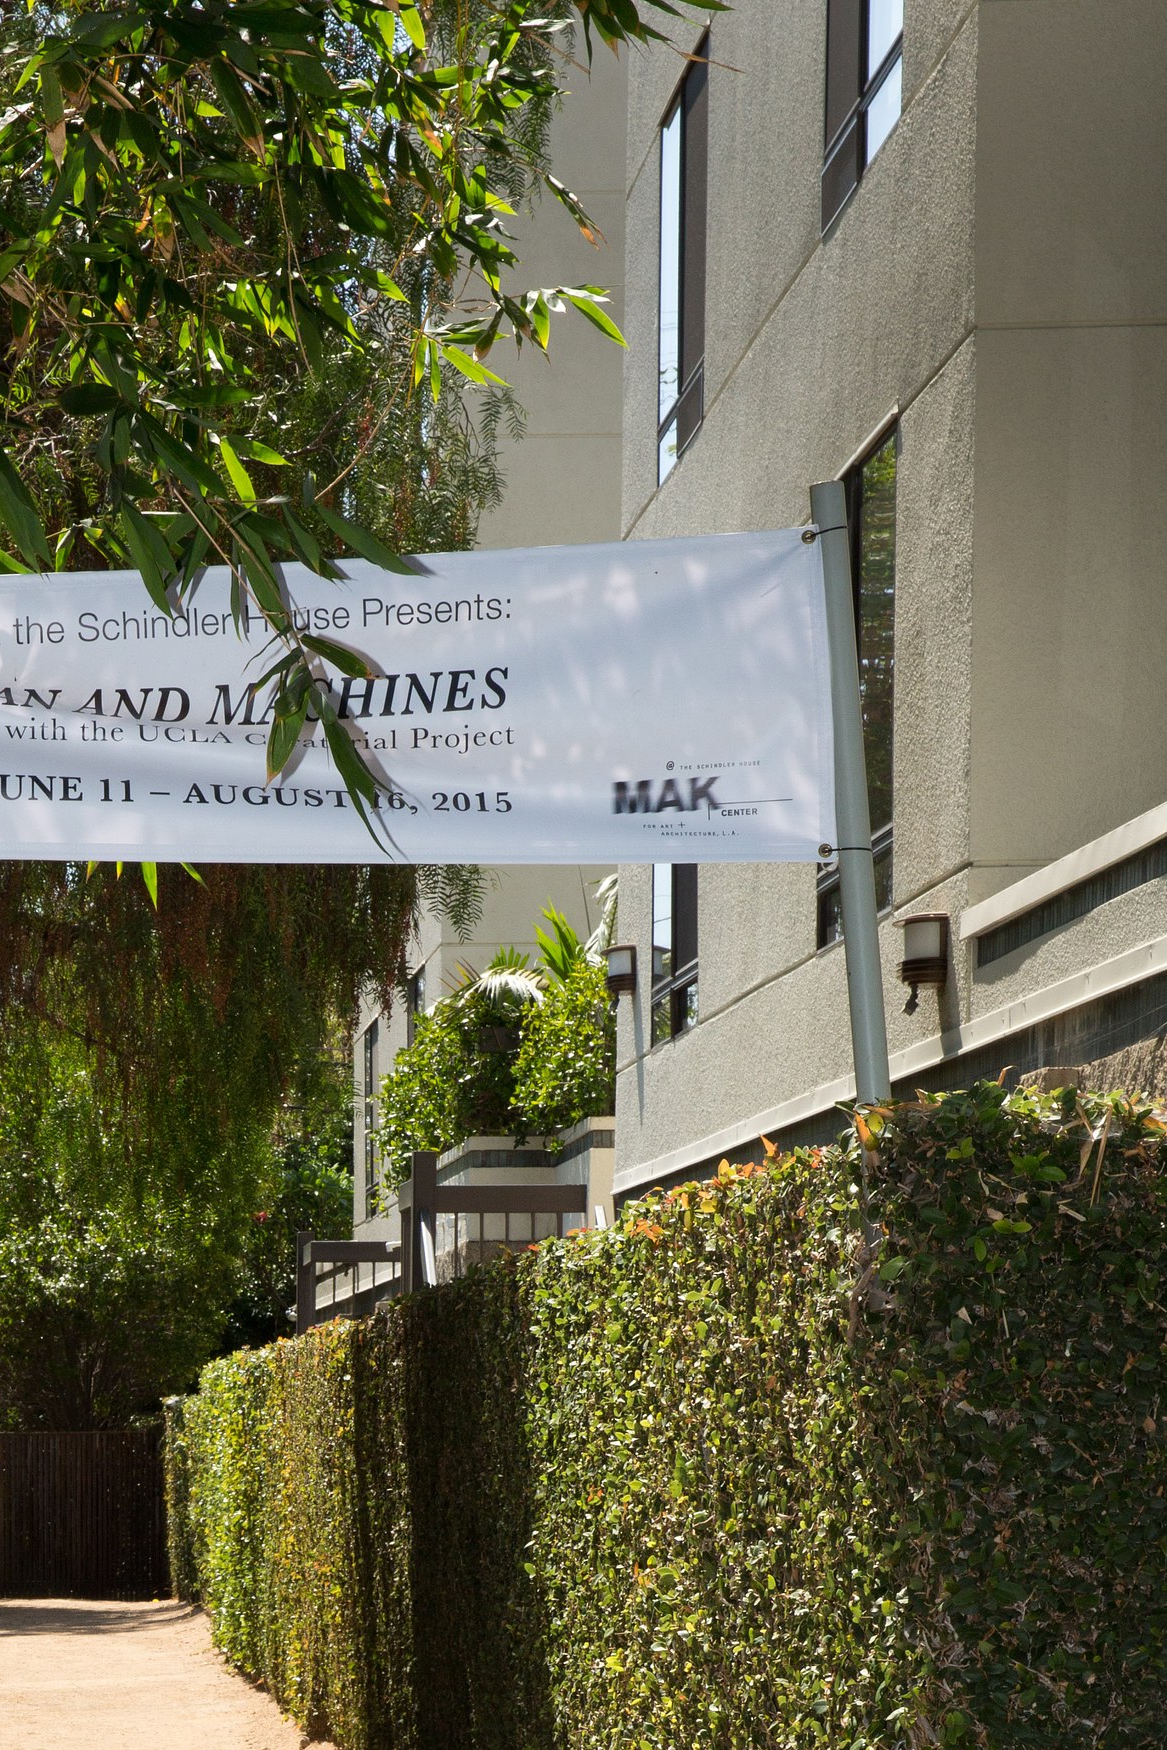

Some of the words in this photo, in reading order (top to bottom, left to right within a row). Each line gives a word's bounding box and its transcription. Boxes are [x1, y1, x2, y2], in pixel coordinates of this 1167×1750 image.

[14, 615, 65, 645] the
[77, 606, 232, 642] Schindler
[245, 604, 350, 634] Huse
[362, 594, 512, 629] Presents:
[72, 687, 190, 722] AND
[6, 717, 67, 742] with
[81, 720, 124, 742] the
[137, 724, 232, 744] UCLA
[411, 725, 515, 754] Project
[697, 762, 735, 770] SCHINDLER
[100, 779, 134, 802] 11
[183, 782, 351, 808] AUGUST
[433, 791, 513, 814] 2015
[612, 775, 720, 815] MAK
[721, 808, 758, 817] CENTER
